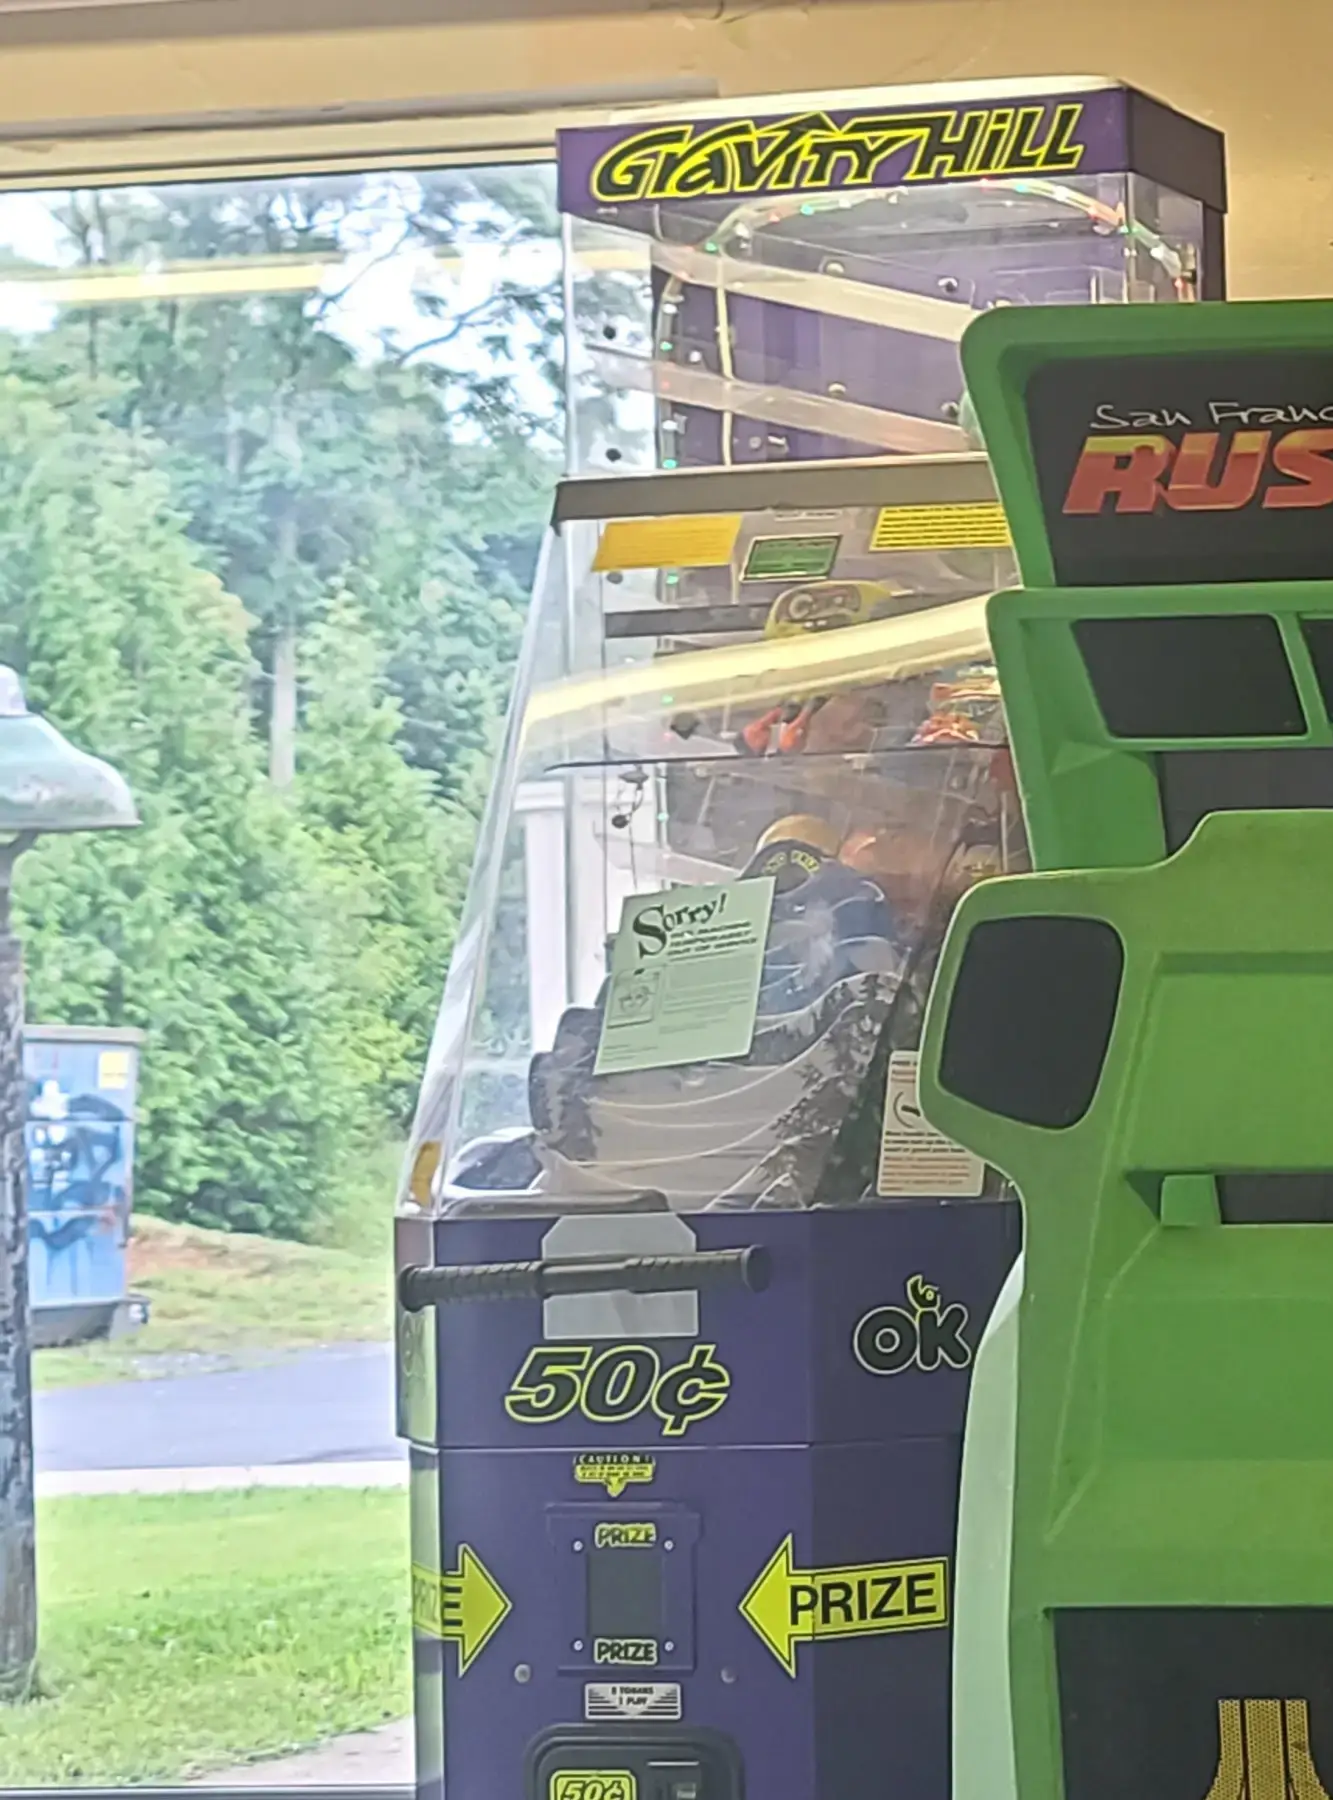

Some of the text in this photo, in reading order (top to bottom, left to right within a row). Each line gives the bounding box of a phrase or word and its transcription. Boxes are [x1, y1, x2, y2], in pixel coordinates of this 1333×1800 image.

[1090, 404, 1192, 429] San
[632, 893, 727, 960] Sorry!
[854, 1303, 972, 1375] OK
[504, 1344, 731, 1436] 50¢
[598, 1525, 656, 1546] PRIZE
[790, 1572, 937, 1626] PRIZE
[596, 1641, 656, 1662] PRIZE
